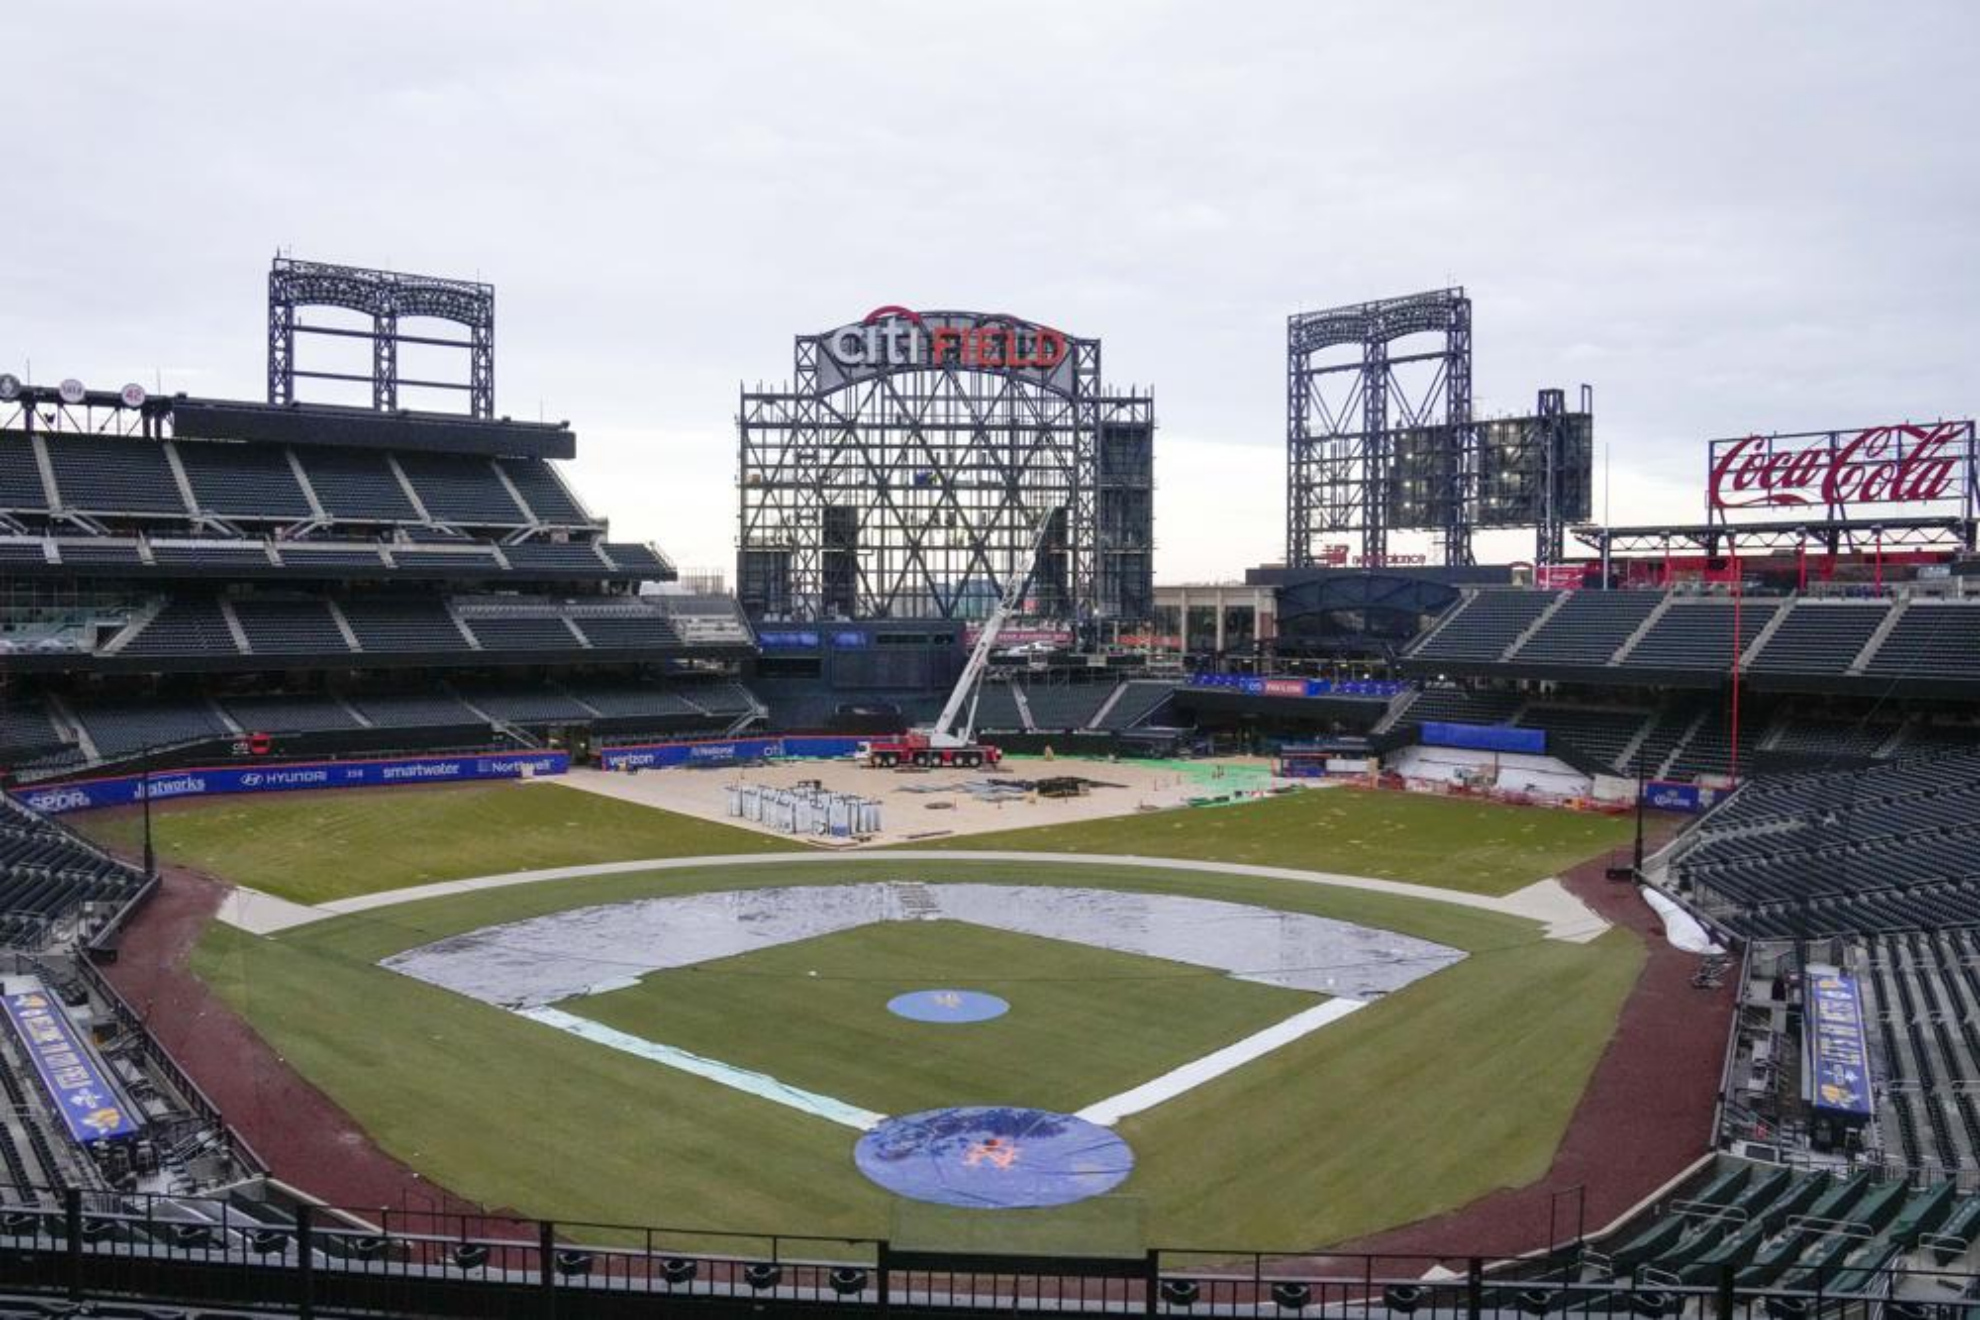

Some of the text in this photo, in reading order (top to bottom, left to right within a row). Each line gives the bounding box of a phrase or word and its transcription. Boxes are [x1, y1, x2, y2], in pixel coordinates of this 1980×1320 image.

[932, 326, 1067, 367] FIELD
[126, 388, 141, 401] 42
[266, 771, 328, 783] HYUNDAI
[383, 762, 460, 778] smartwater
